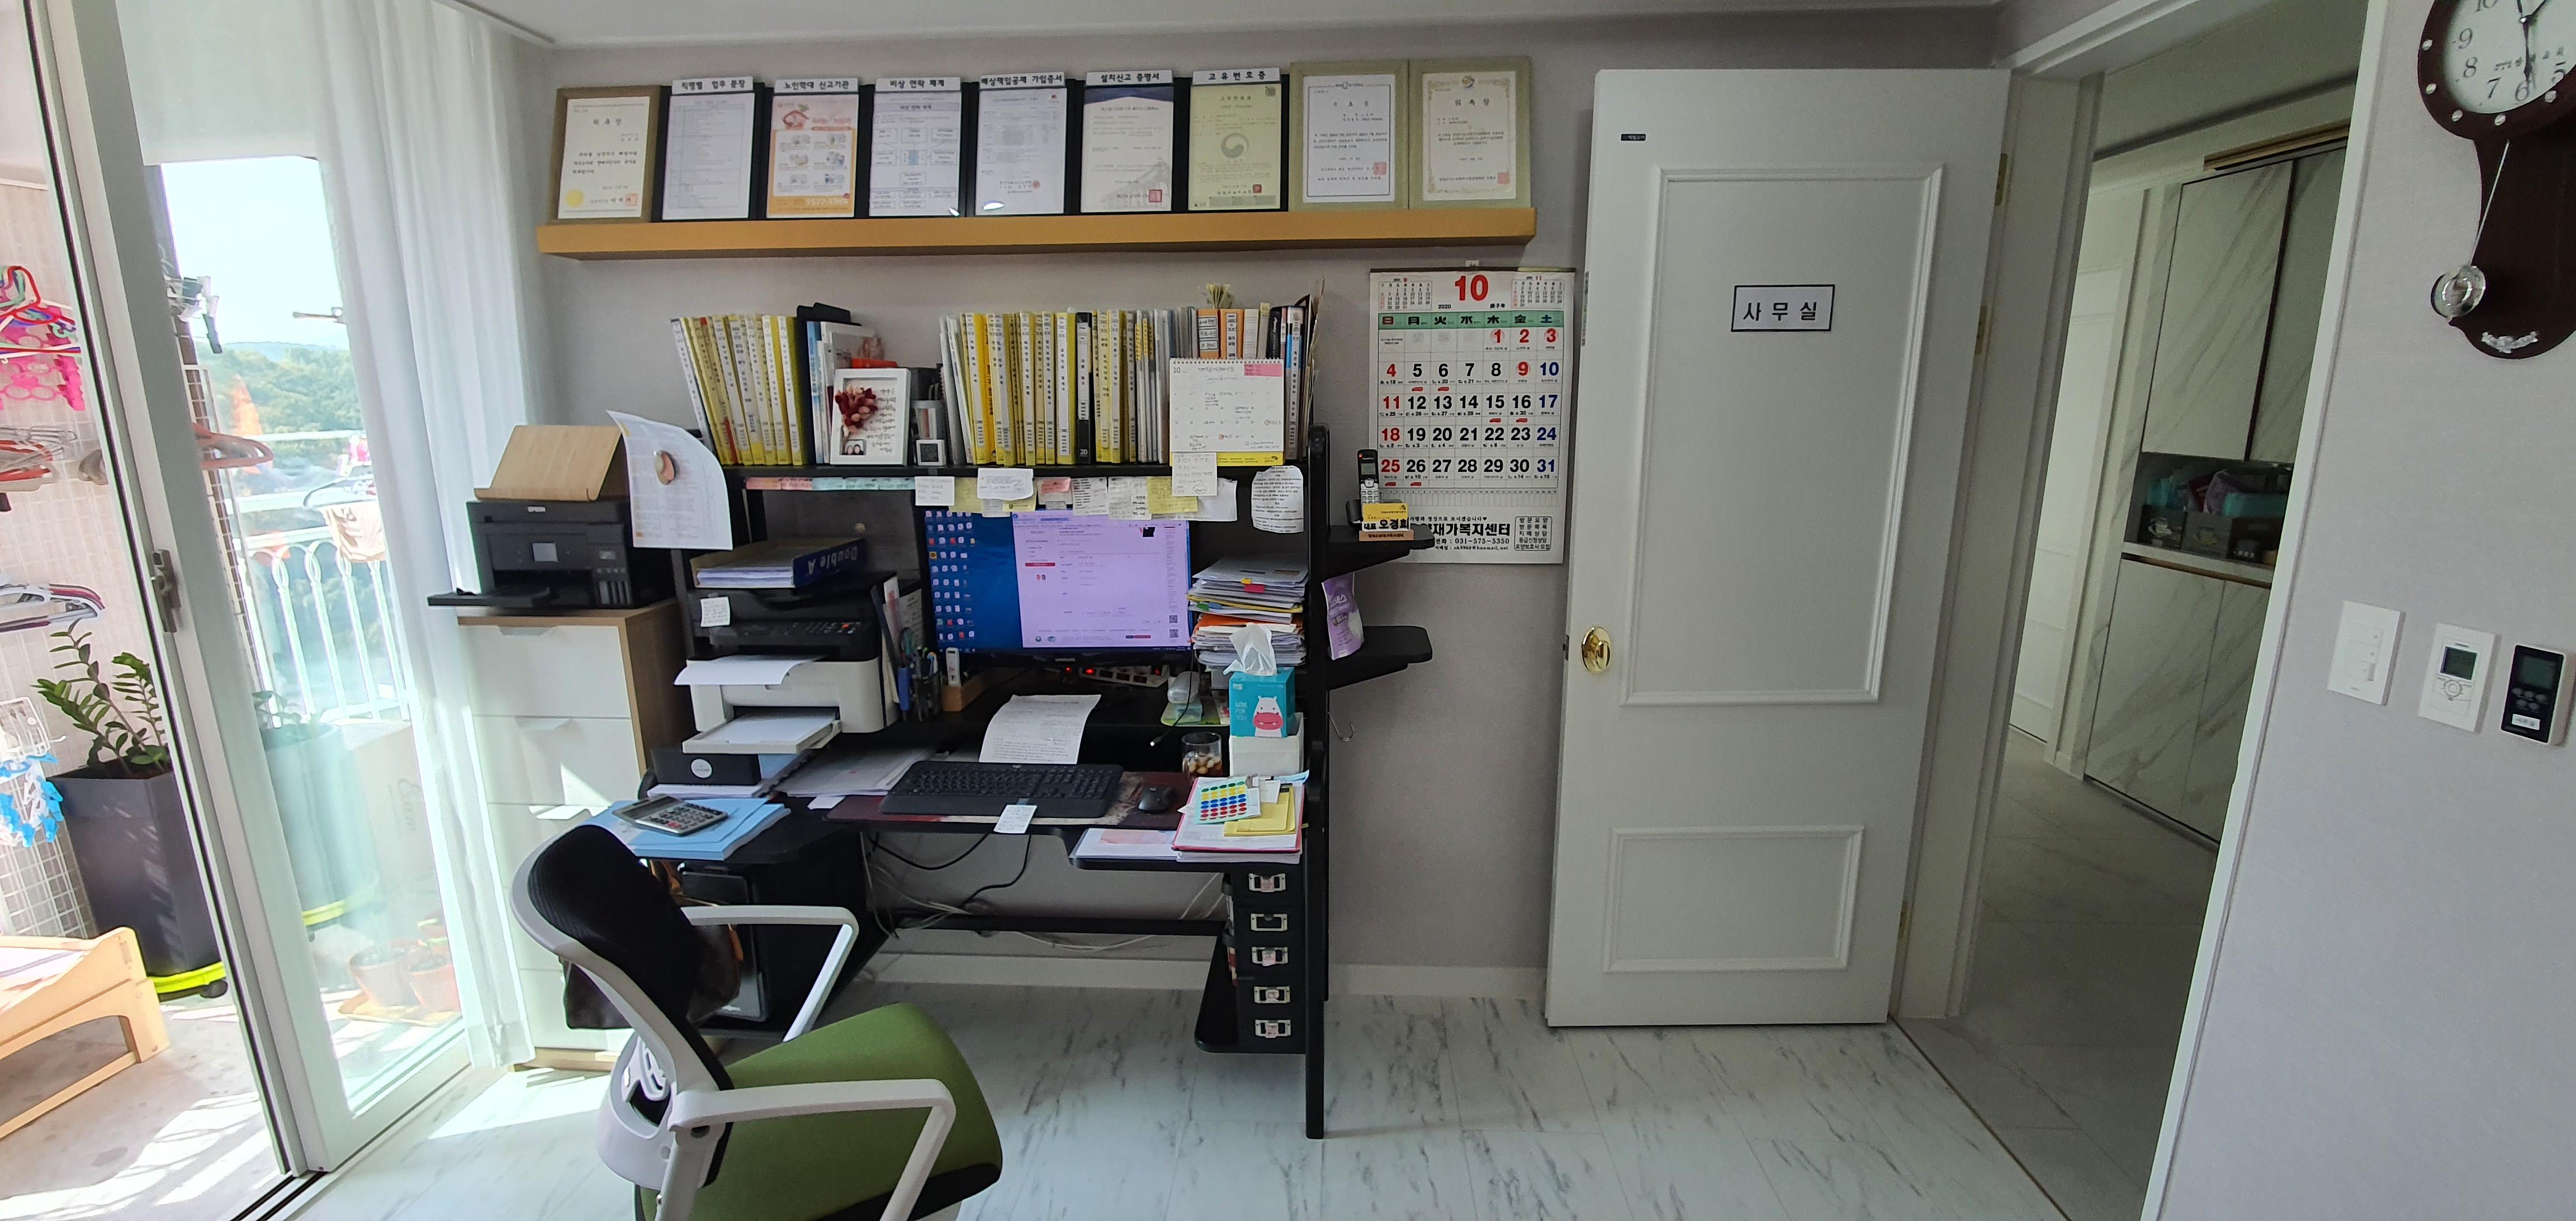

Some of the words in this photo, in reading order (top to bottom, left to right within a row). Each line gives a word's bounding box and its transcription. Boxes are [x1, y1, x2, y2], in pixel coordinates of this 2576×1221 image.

[2458, 28, 2473, 49] 9
[2463, 56, 2478, 78] 8
[1032, 75, 1062, 84] 가입증서
[1101, 74, 1132, 82] 설치신고
[1136, 73, 1160, 82] 증명서
[819, 81, 850, 89] 신고기관
[2487, 77, 2501, 99] 7
[2515, 81, 2530, 102] 6
[1455, 275, 1489, 301] 10
[1743, 301, 1818, 321] 사무실
[1382, 316, 1394, 325] 日
[1408, 316, 1420, 325] 月
[1434, 316, 1447, 325] 火
[1460, 315, 1473, 324] 水
[1486, 315, 1500, 324] 木
[1514, 314, 1527, 324] 金
[1541, 314, 1553, 324] 土
[1494, 329, 1502, 343] 1
[1519, 329, 1530, 343] 2
[1546, 328, 1557, 343] 3
[1386, 363, 1396, 377] 4
[1413, 364, 1422, 377] 5
[1438, 363, 1448, 377] 6
[1465, 363, 1474, 376] 7
[1491, 363, 1502, 377] 8
[1518, 362, 1529, 376] 9
[1540, 362, 1559, 376] 10
[1383, 396, 1399, 409] 11
[1408, 396, 1426, 409] 12
[1434, 396, 1452, 409] 13
[1460, 395, 1478, 409] 14
[1486, 395, 1505, 409] 15
[1512, 395, 1531, 408] 16
[1539, 394, 1558, 408] 17
[1381, 428, 1400, 441] 18
[1407, 428, 1426, 441] 19
[1432, 428, 1452, 441] 20
[1460, 427, 1478, 441] 21
[1484, 427, 1504, 441] 22
[1510, 427, 1531, 441] 23
[1537, 427, 1557, 441] 24
[1381, 459, 1400, 473] 25
[1407, 459, 1426, 472] 26
[1432, 459, 1452, 472] 27
[1457, 459, 1478, 472] 28
[1484, 459, 1503, 472] 29
[1509, 459, 1530, 472] 30
[1537, 459, 1555, 472] 31
[1428, 523, 1510, 536] 재가복지센터
